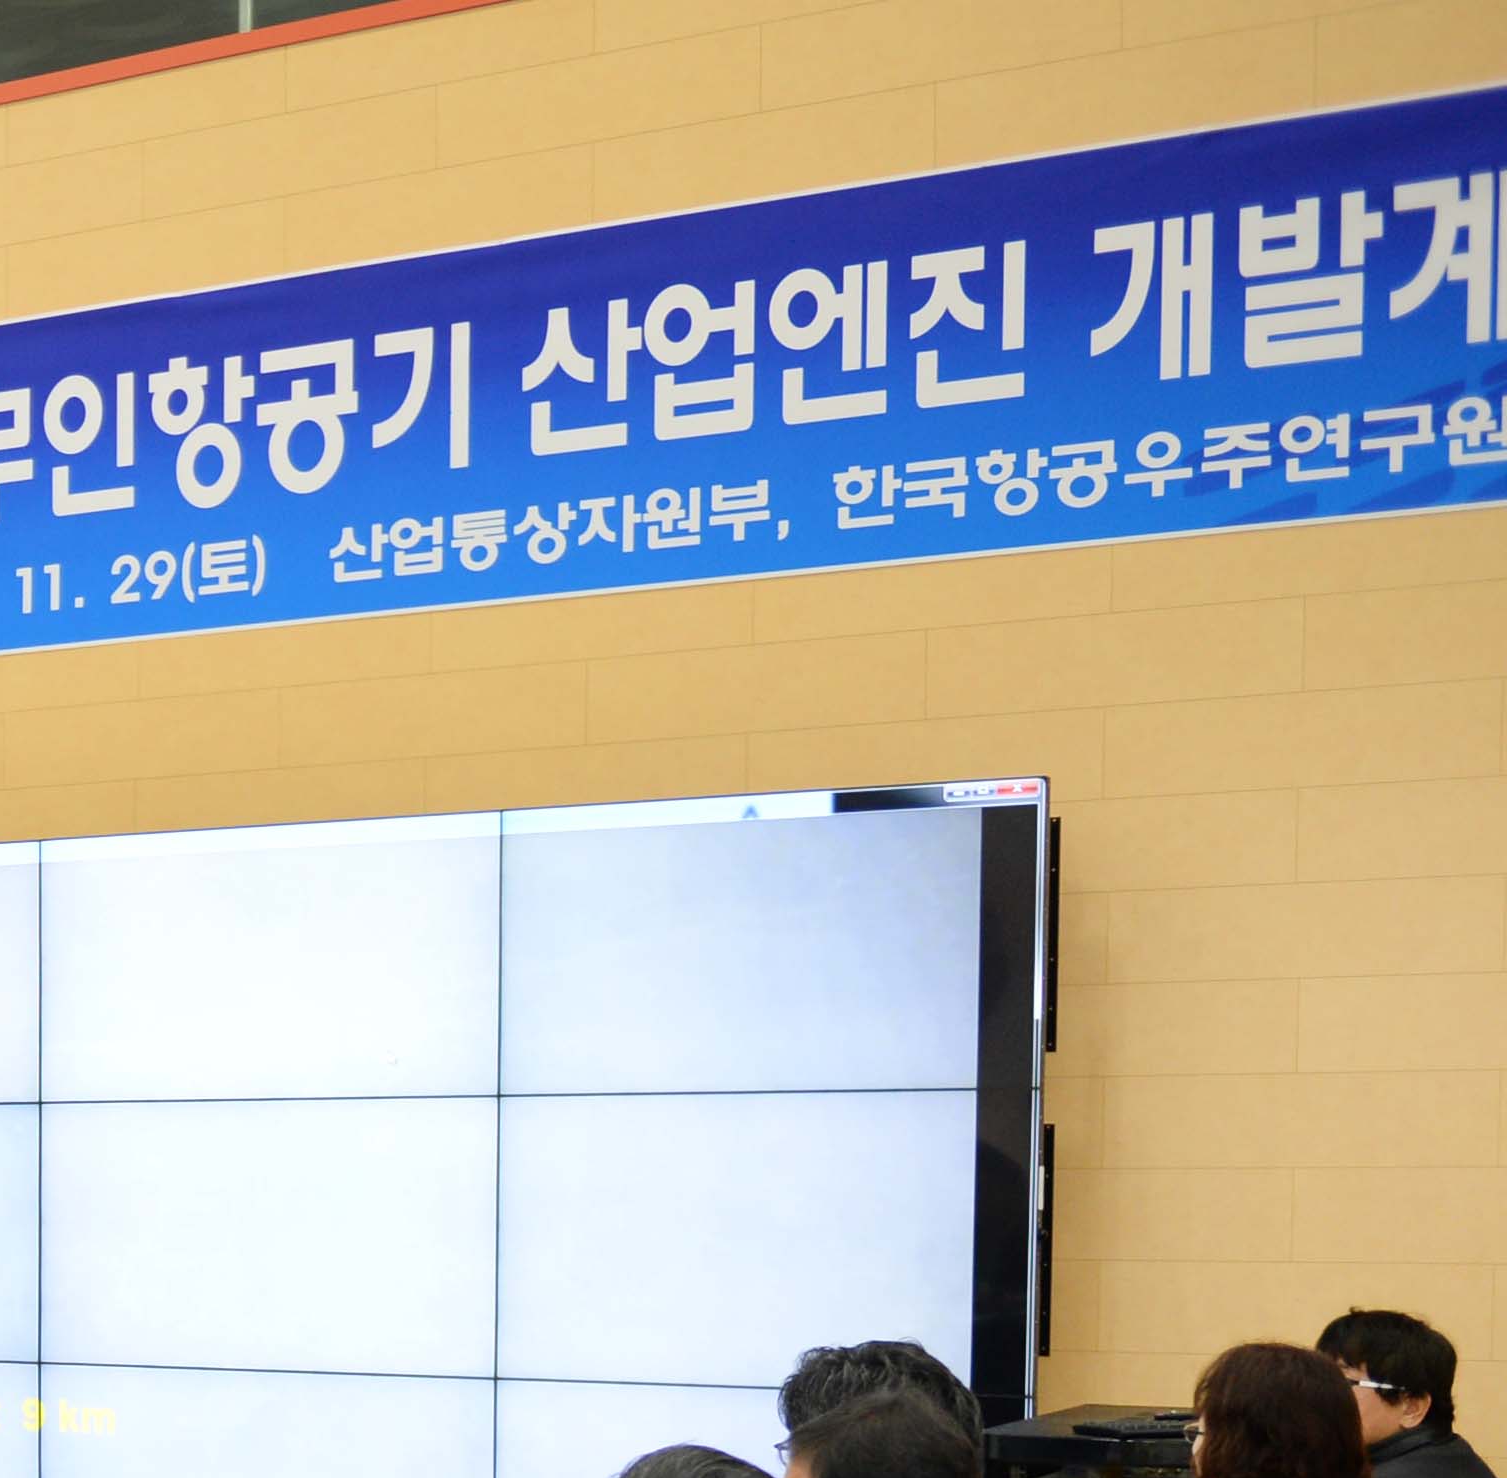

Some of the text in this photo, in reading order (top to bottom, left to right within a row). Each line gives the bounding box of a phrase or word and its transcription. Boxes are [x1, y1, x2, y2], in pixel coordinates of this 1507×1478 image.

[521, 239, 1027, 457] 산업엔진
[15, 564, 86, 614] 11.
[111, 535, 267, 605] 29(토)
[329, 479, 790, 583] 산업통상자원부,
[833, 395, 1507, 529] 한국항공우주연구원
[21, 1397, 46, 1432] 9
[58, 1397, 117, 1435] km
